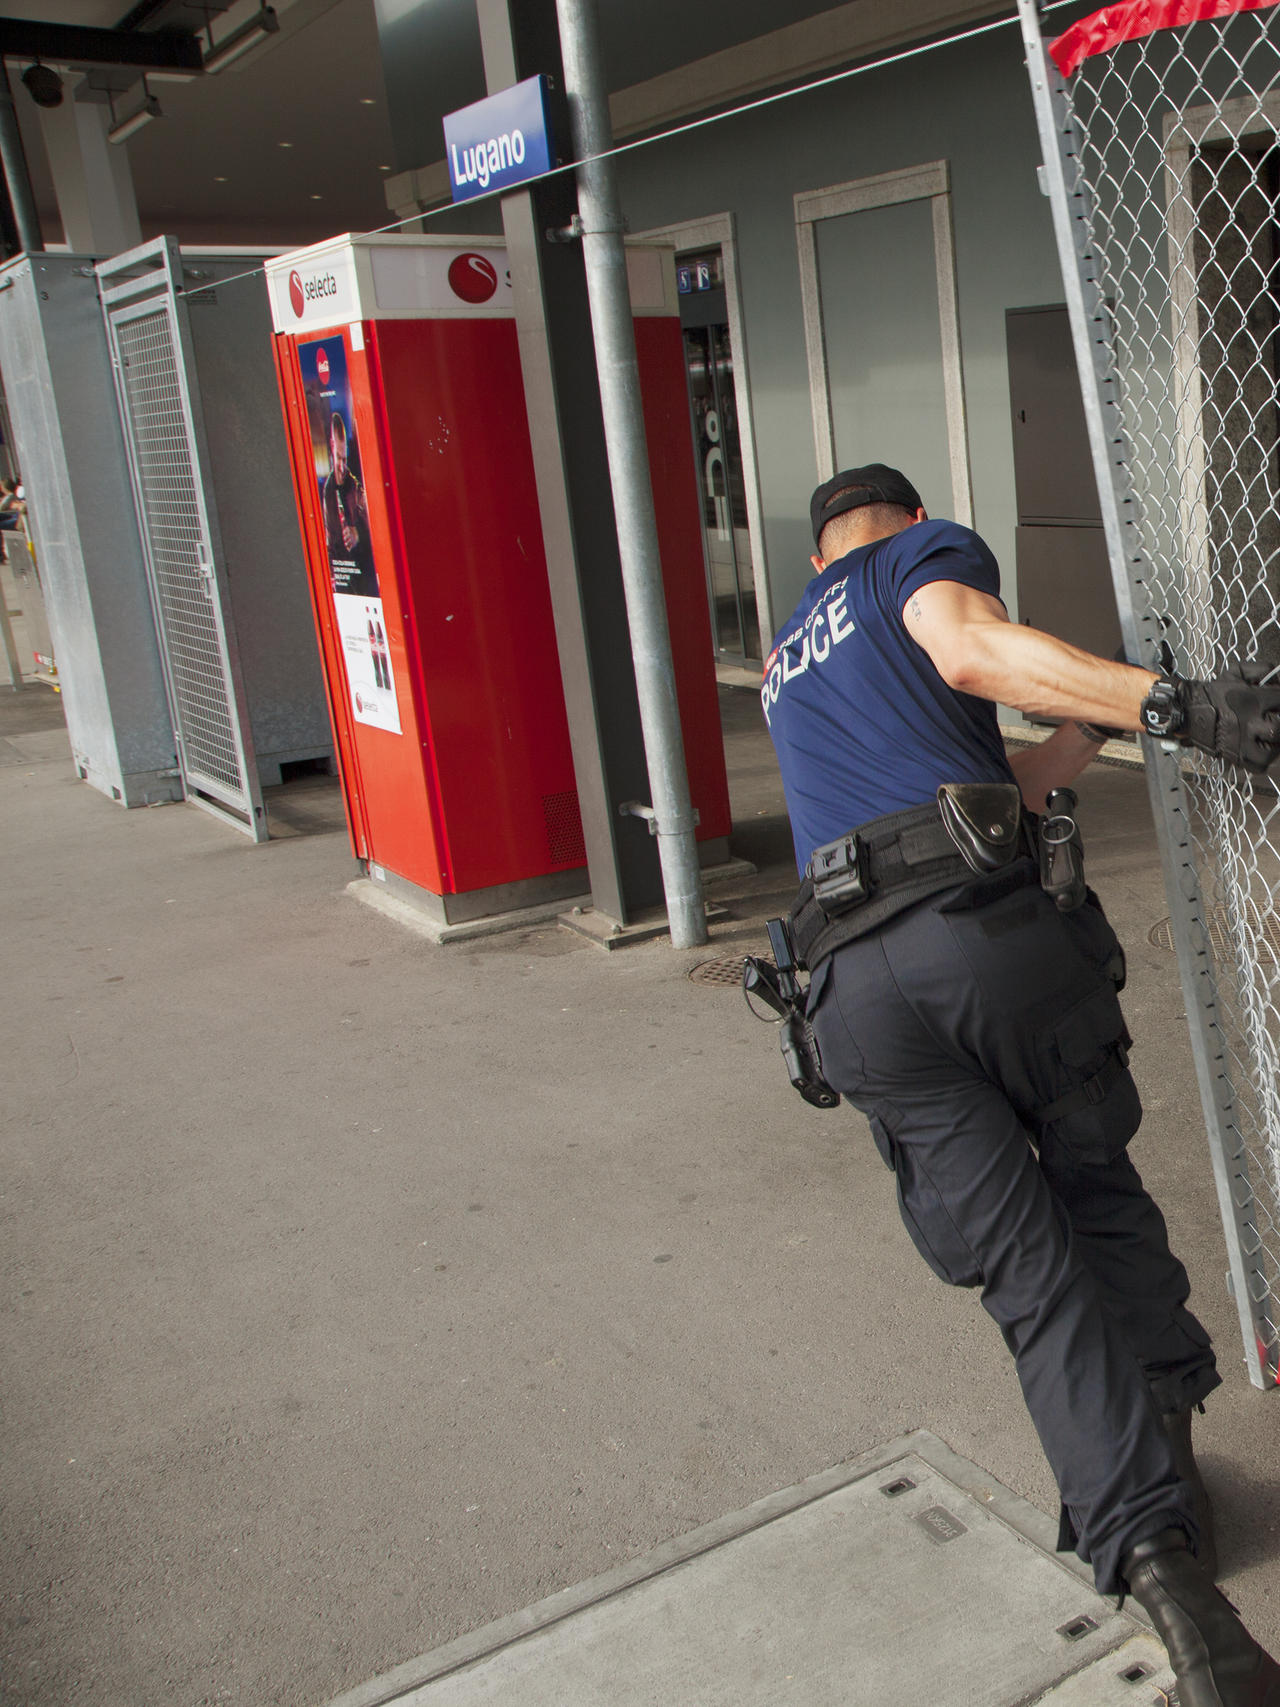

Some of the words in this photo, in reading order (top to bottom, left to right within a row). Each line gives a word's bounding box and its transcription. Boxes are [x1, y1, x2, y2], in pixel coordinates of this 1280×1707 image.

[451, 129, 526, 188] Lugano
[304, 272, 337, 301] selecta
[761, 590, 856, 728] POLICE
